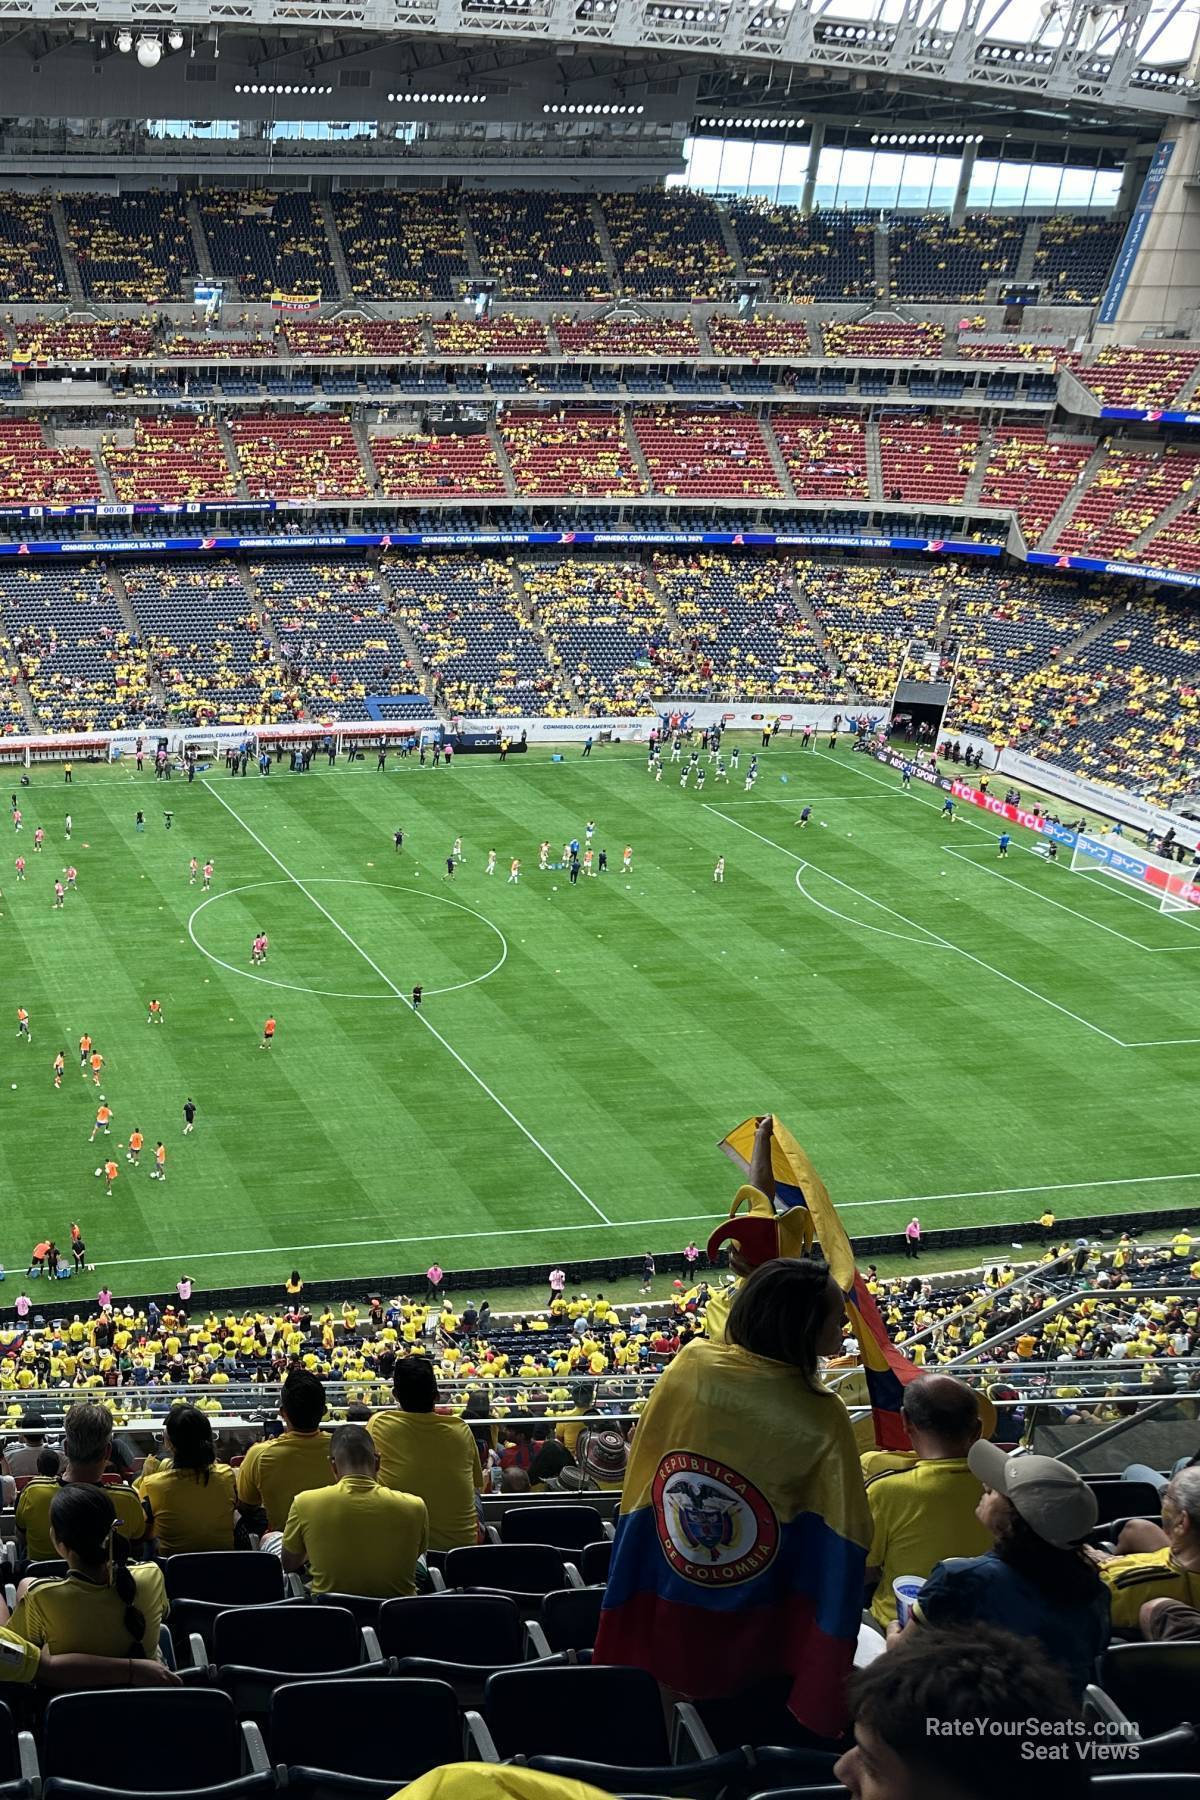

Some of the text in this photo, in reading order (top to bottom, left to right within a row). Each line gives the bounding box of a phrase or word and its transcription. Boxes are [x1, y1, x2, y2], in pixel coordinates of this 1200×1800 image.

[916, 769, 938, 784] SPORT
[954, 784, 978, 802] TCL
[984, 797, 1008, 818] TCL
[1016, 811, 1043, 832] TCL
[658, 1456, 746, 1495] REPUBLICA
[664, 1538, 678, 1560] DE
[684, 1544, 770, 1579] COLOMBIA
